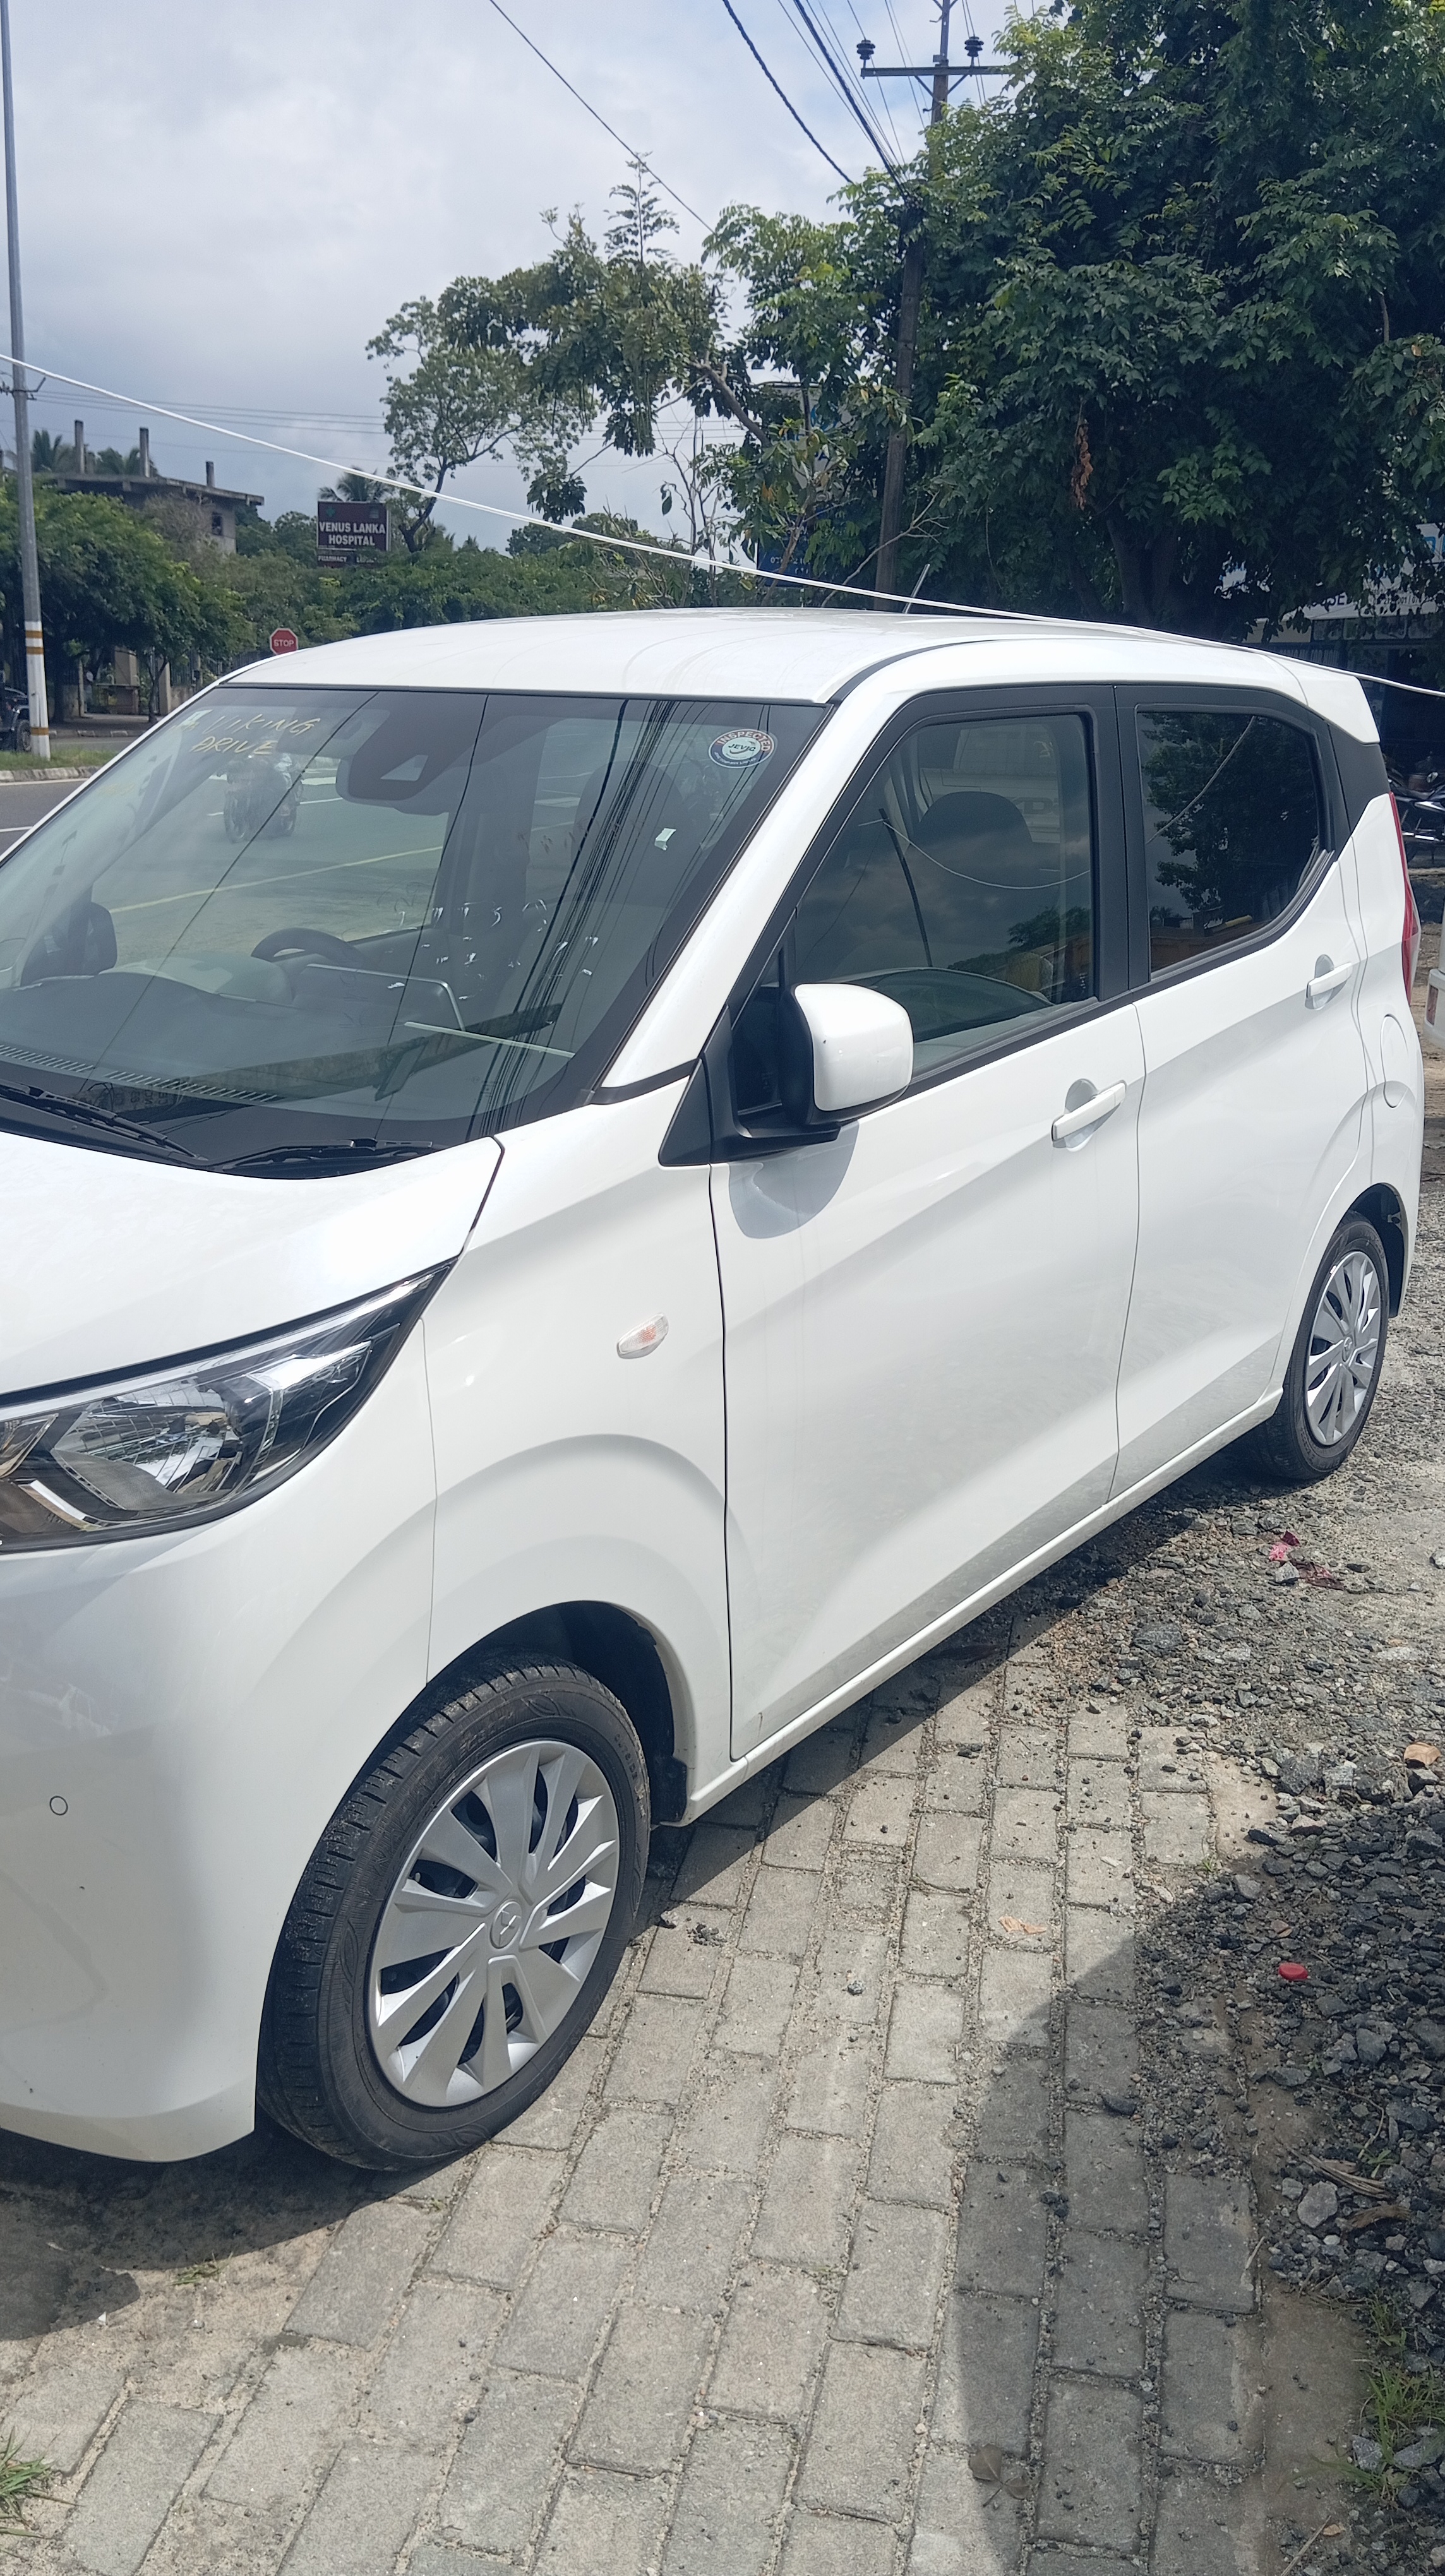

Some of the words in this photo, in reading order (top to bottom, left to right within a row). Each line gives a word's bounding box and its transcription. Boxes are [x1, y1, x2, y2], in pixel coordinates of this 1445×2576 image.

[319, 522, 351, 532] VENUS
[354, 523, 386, 534] LANKA
[329, 535, 375, 546] HOSPITAL
[273, 639, 294, 647] STOP
[189, 736, 278, 755] DRIVE
[717, 731, 770, 751] INSPECTED
